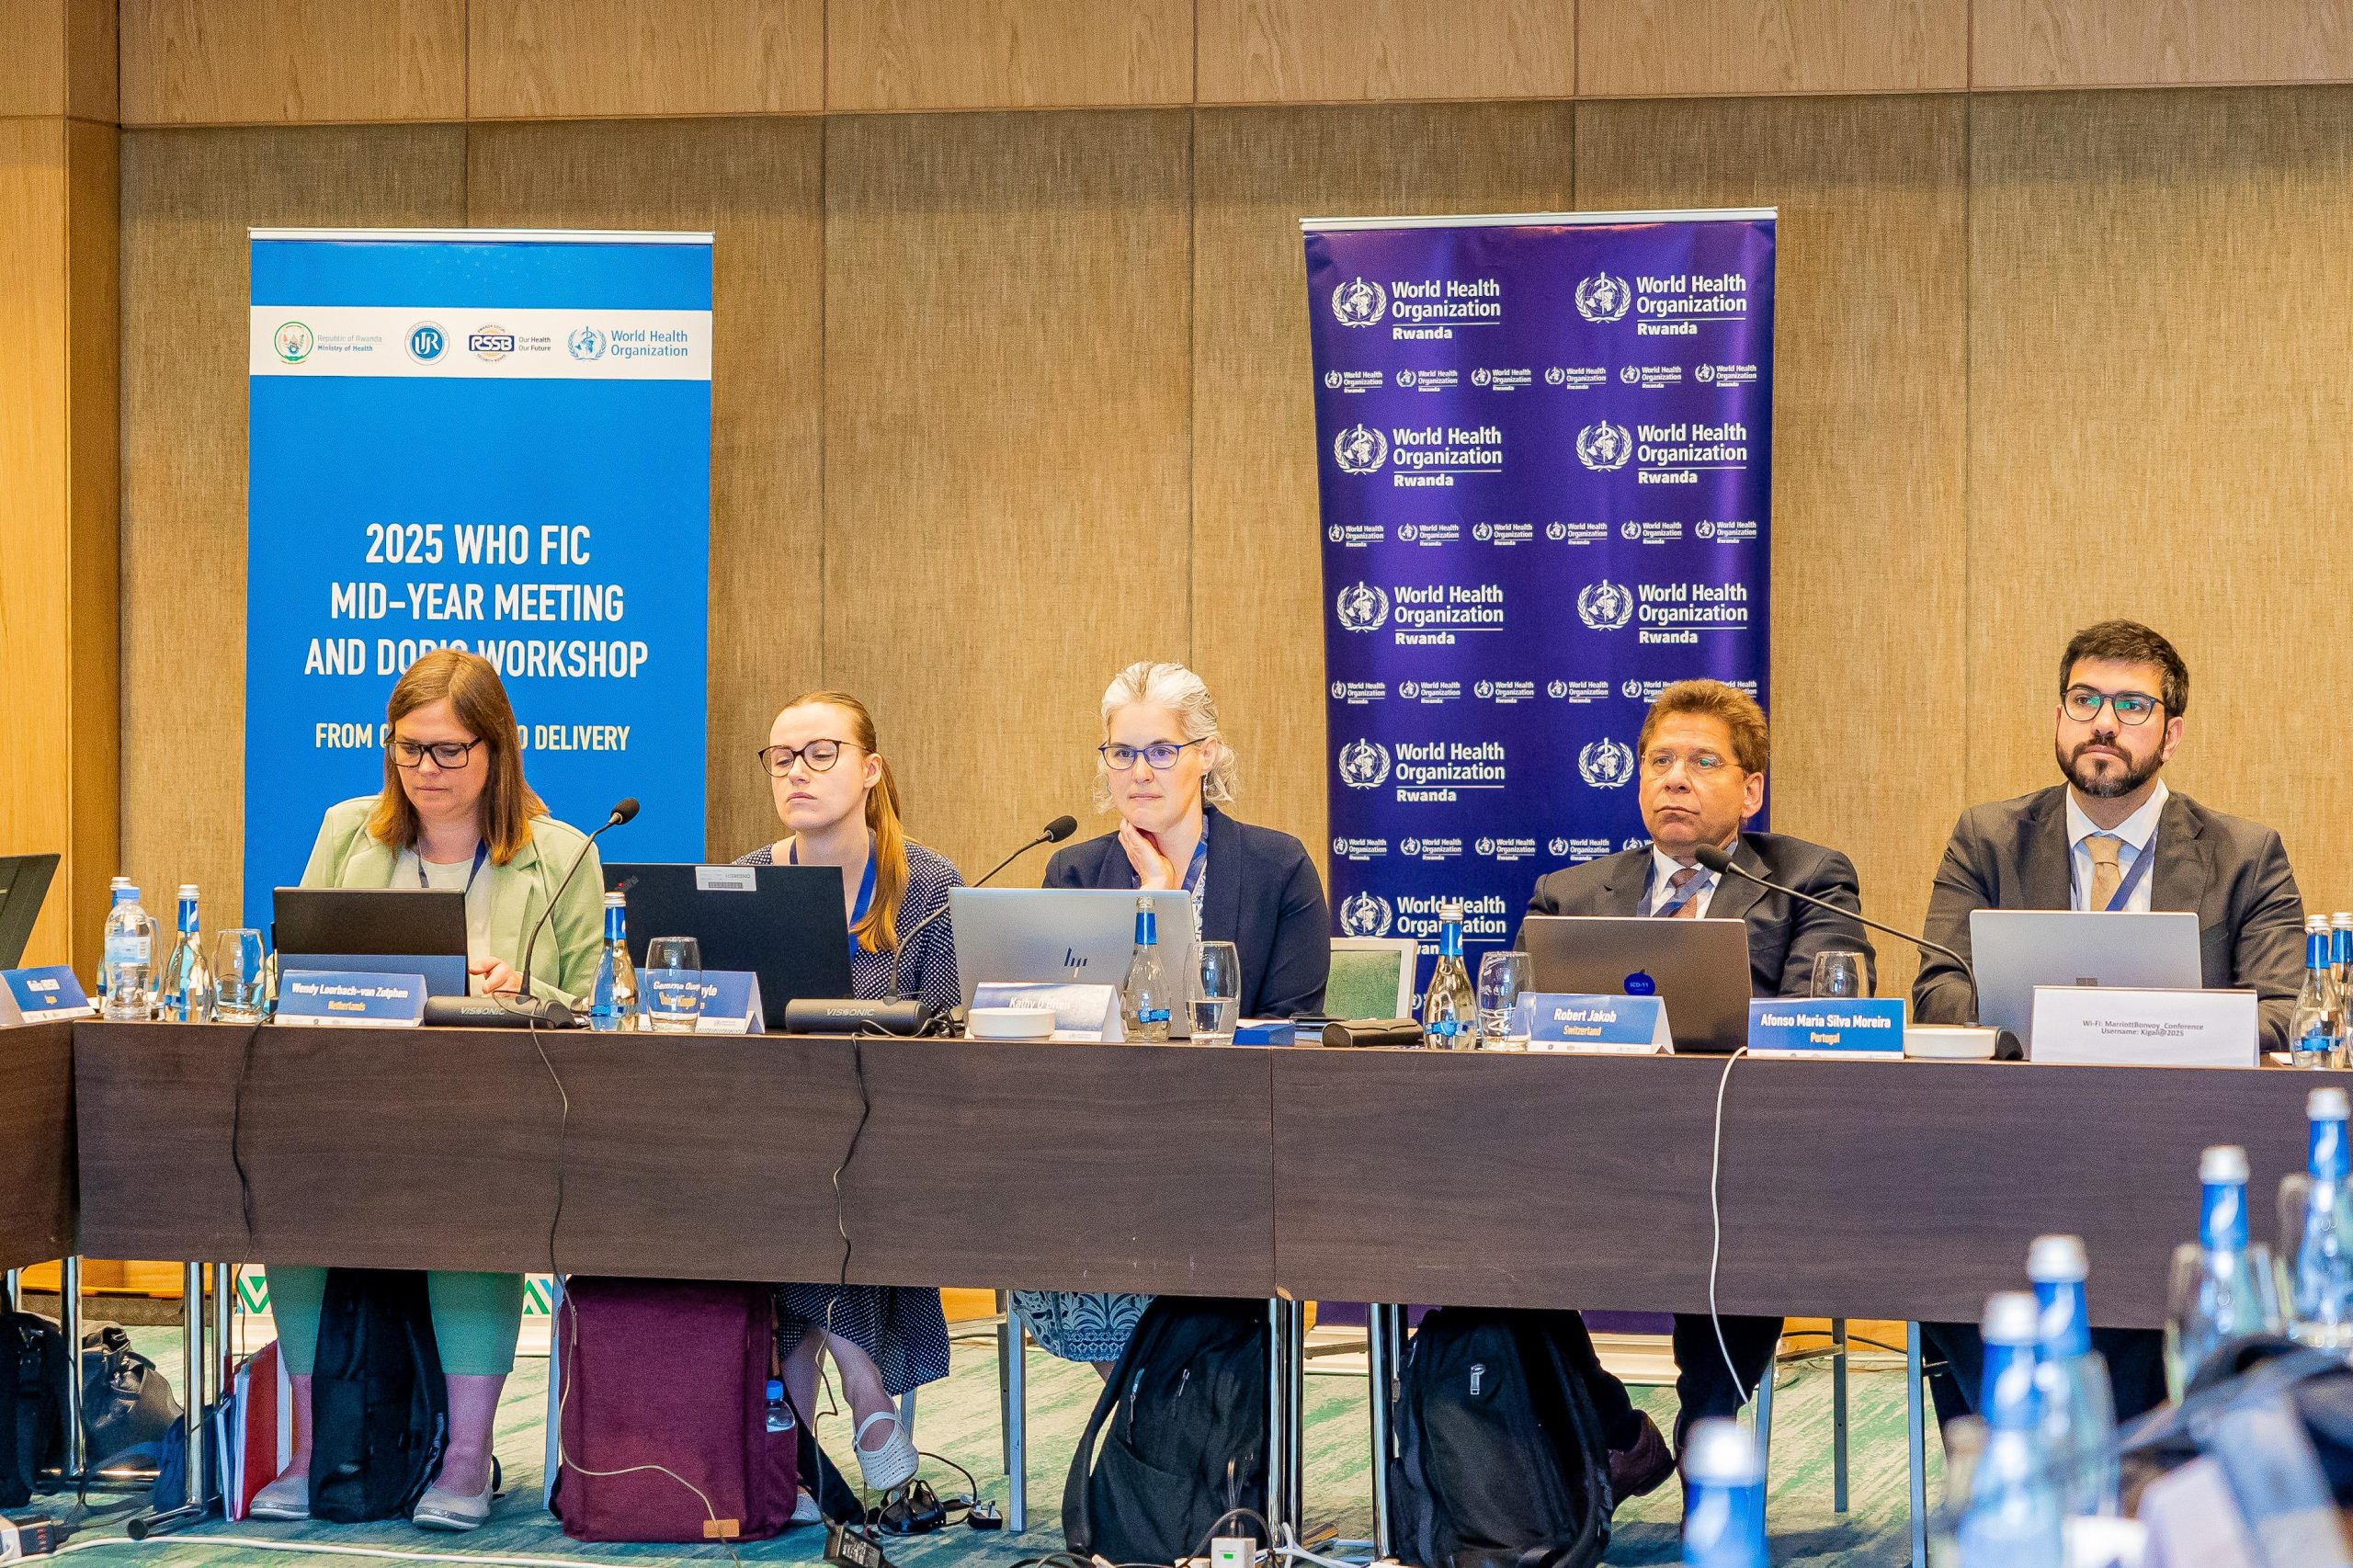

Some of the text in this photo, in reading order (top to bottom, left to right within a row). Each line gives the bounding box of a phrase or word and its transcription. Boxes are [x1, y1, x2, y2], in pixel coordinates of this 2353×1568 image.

[1392, 278, 1499, 298] World Health
[1636, 274, 1746, 293] World Health
[1392, 299, 1500, 322] Organization
[1637, 294, 1747, 316] Organization
[1392, 326, 1452, 341] Rwanda
[1638, 322, 1698, 335] Rwanda
[317, 335, 382, 344] Republic of Rwanda
[611, 329, 688, 343] World Health
[317, 345, 342, 353] Ministry
[471, 335, 513, 351] RSSB
[610, 344, 688, 358] Organization
[1438, 369, 1458, 378] Health
[1492, 369, 1531, 377] World Health
[1662, 366, 1681, 374] Health
[1344, 378, 1382, 386] Organization
[1418, 377, 1458, 385] Organization
[1642, 373, 1681, 381] Organization
[1392, 426, 1501, 445] World Health
[1637, 421, 1746, 441] World Health
[1393, 447, 1502, 469] Organization
[1638, 443, 1747, 467] Organization
[1394, 473, 1454, 487] Rwanda
[1639, 471, 1698, 483] Rwanda
[1364, 525, 1384, 533] Health
[1438, 524, 1459, 532] Health
[1717, 520, 1756, 529] World Health
[1419, 531, 1460, 540] Organization
[1494, 530, 1533, 539] Organization
[1643, 528, 1682, 537] Organization
[1717, 528, 1756, 537] Organization
[366, 523, 591, 565] 2025 WHO FIC
[1394, 585, 1504, 603] World Health
[1638, 583, 1746, 601] World Health
[331, 582, 624, 622] MID-YEAR MEETING
[1394, 605, 1503, 629] Organization
[1639, 604, 1747, 626] Organization
[1395, 631, 1455, 644] Rwanda
[1640, 631, 1699, 643] Rwanda
[304, 638, 366, 676] AND
[1347, 682, 1385, 690] World Health
[1495, 681, 1534, 689] World Health
[1569, 681, 1608, 689] World Health
[1347, 689, 1385, 698] Organization
[1421, 688, 1461, 697] Organization
[1495, 688, 1534, 697] Organization
[1569, 688, 1608, 697] Organization
[315, 722, 373, 749] FROM
[535, 724, 631, 751] DELIVERY
[1395, 742, 1505, 760] World Health
[1396, 762, 1506, 784] Organization
[1397, 788, 1457, 801] Rwanda
[1422, 838, 1461, 846] World Health
[1496, 838, 1535, 846] World Health
[1347, 846, 1387, 854] Organization
[1496, 846, 1536, 854] Organization
[1397, 895, 1446, 914] World
[292, 983, 319, 995] Wendy
[460, 1007, 506, 1016] VISSONIC
[827, 1008, 875, 1017] VISSONIC
[1554, 1008, 1618, 1023] Robert Jakob
[1761, 1014, 1892, 1028] Afonso Maria Silva Moreira
[1563, 1025, 1601, 1036] Switzerland
[1810, 1032, 1840, 1045] Portugal
